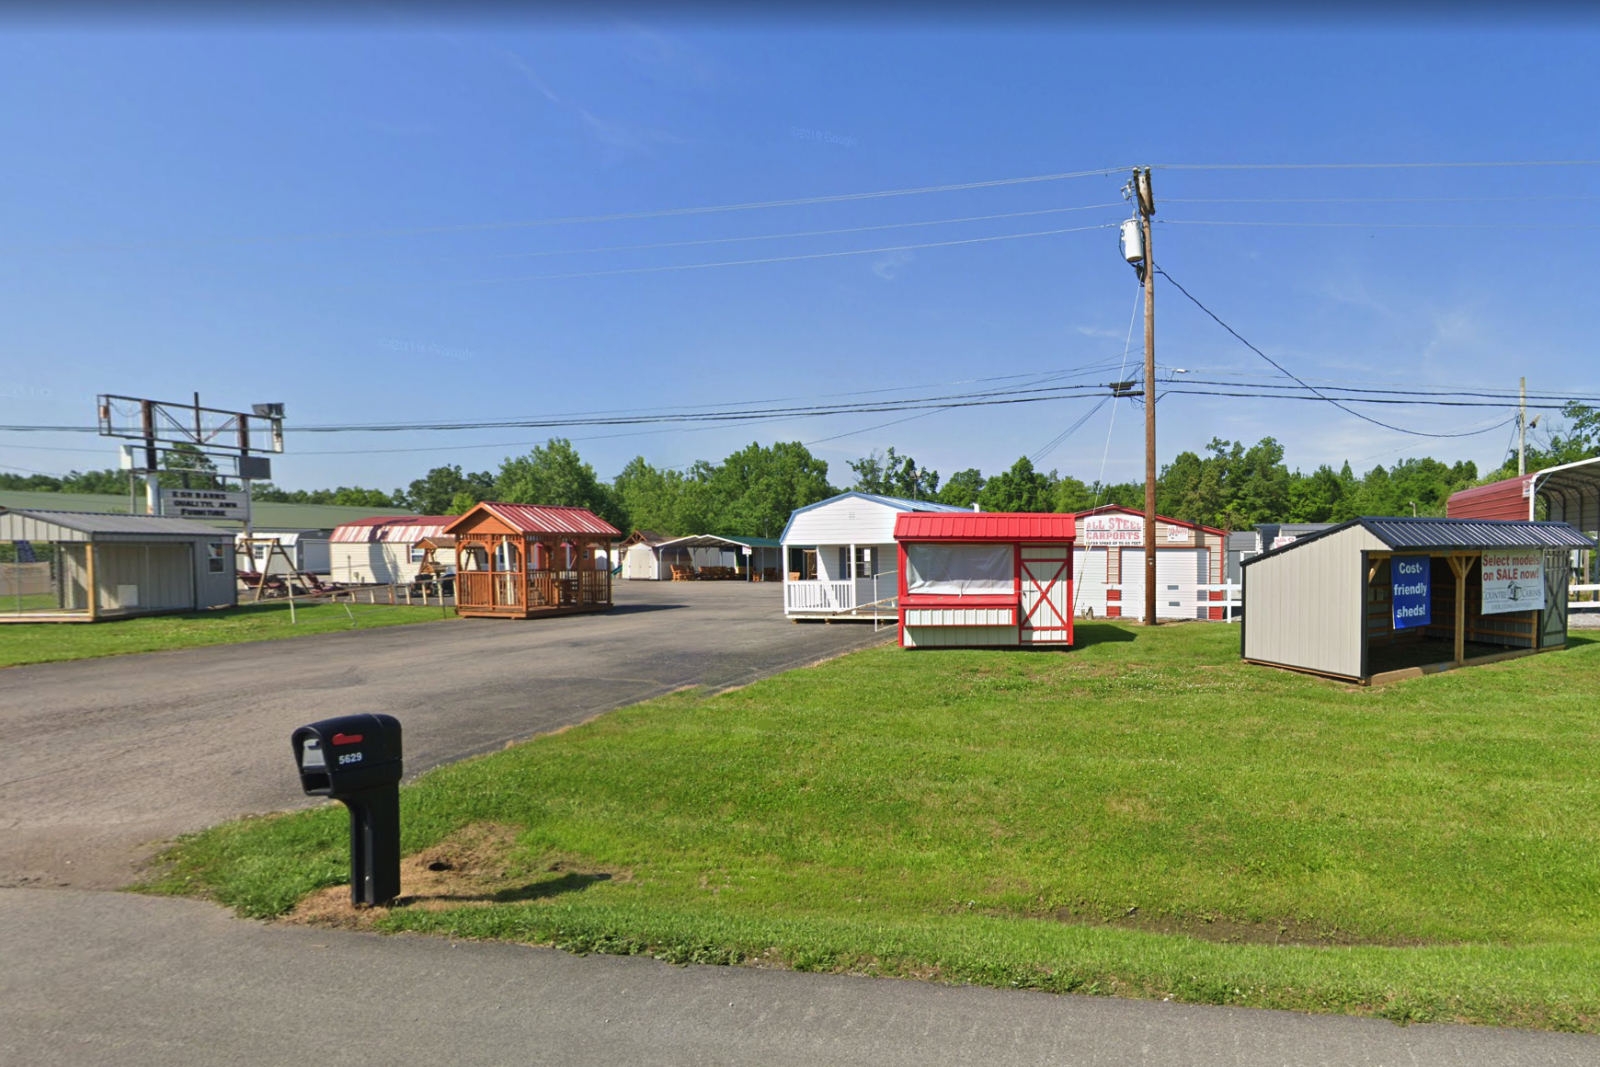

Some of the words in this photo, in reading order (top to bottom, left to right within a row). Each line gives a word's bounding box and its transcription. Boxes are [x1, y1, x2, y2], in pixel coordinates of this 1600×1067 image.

[1086, 519, 1105, 530] ALL
[1108, 516, 1142, 530] STEEL
[1086, 531, 1141, 541] CARPORTS
[1482, 554, 1510, 567] Select
[1512, 554, 1541, 566] models
[1398, 561, 1423, 575] Cost-
[1483, 571, 1495, 581] on
[1496, 568, 1518, 581] SALE
[1520, 567, 1540, 579] now!
[1393, 582, 1428, 597] friendly
[1396, 603, 1426, 619] sheds!
[338, 752, 363, 765] 5629
